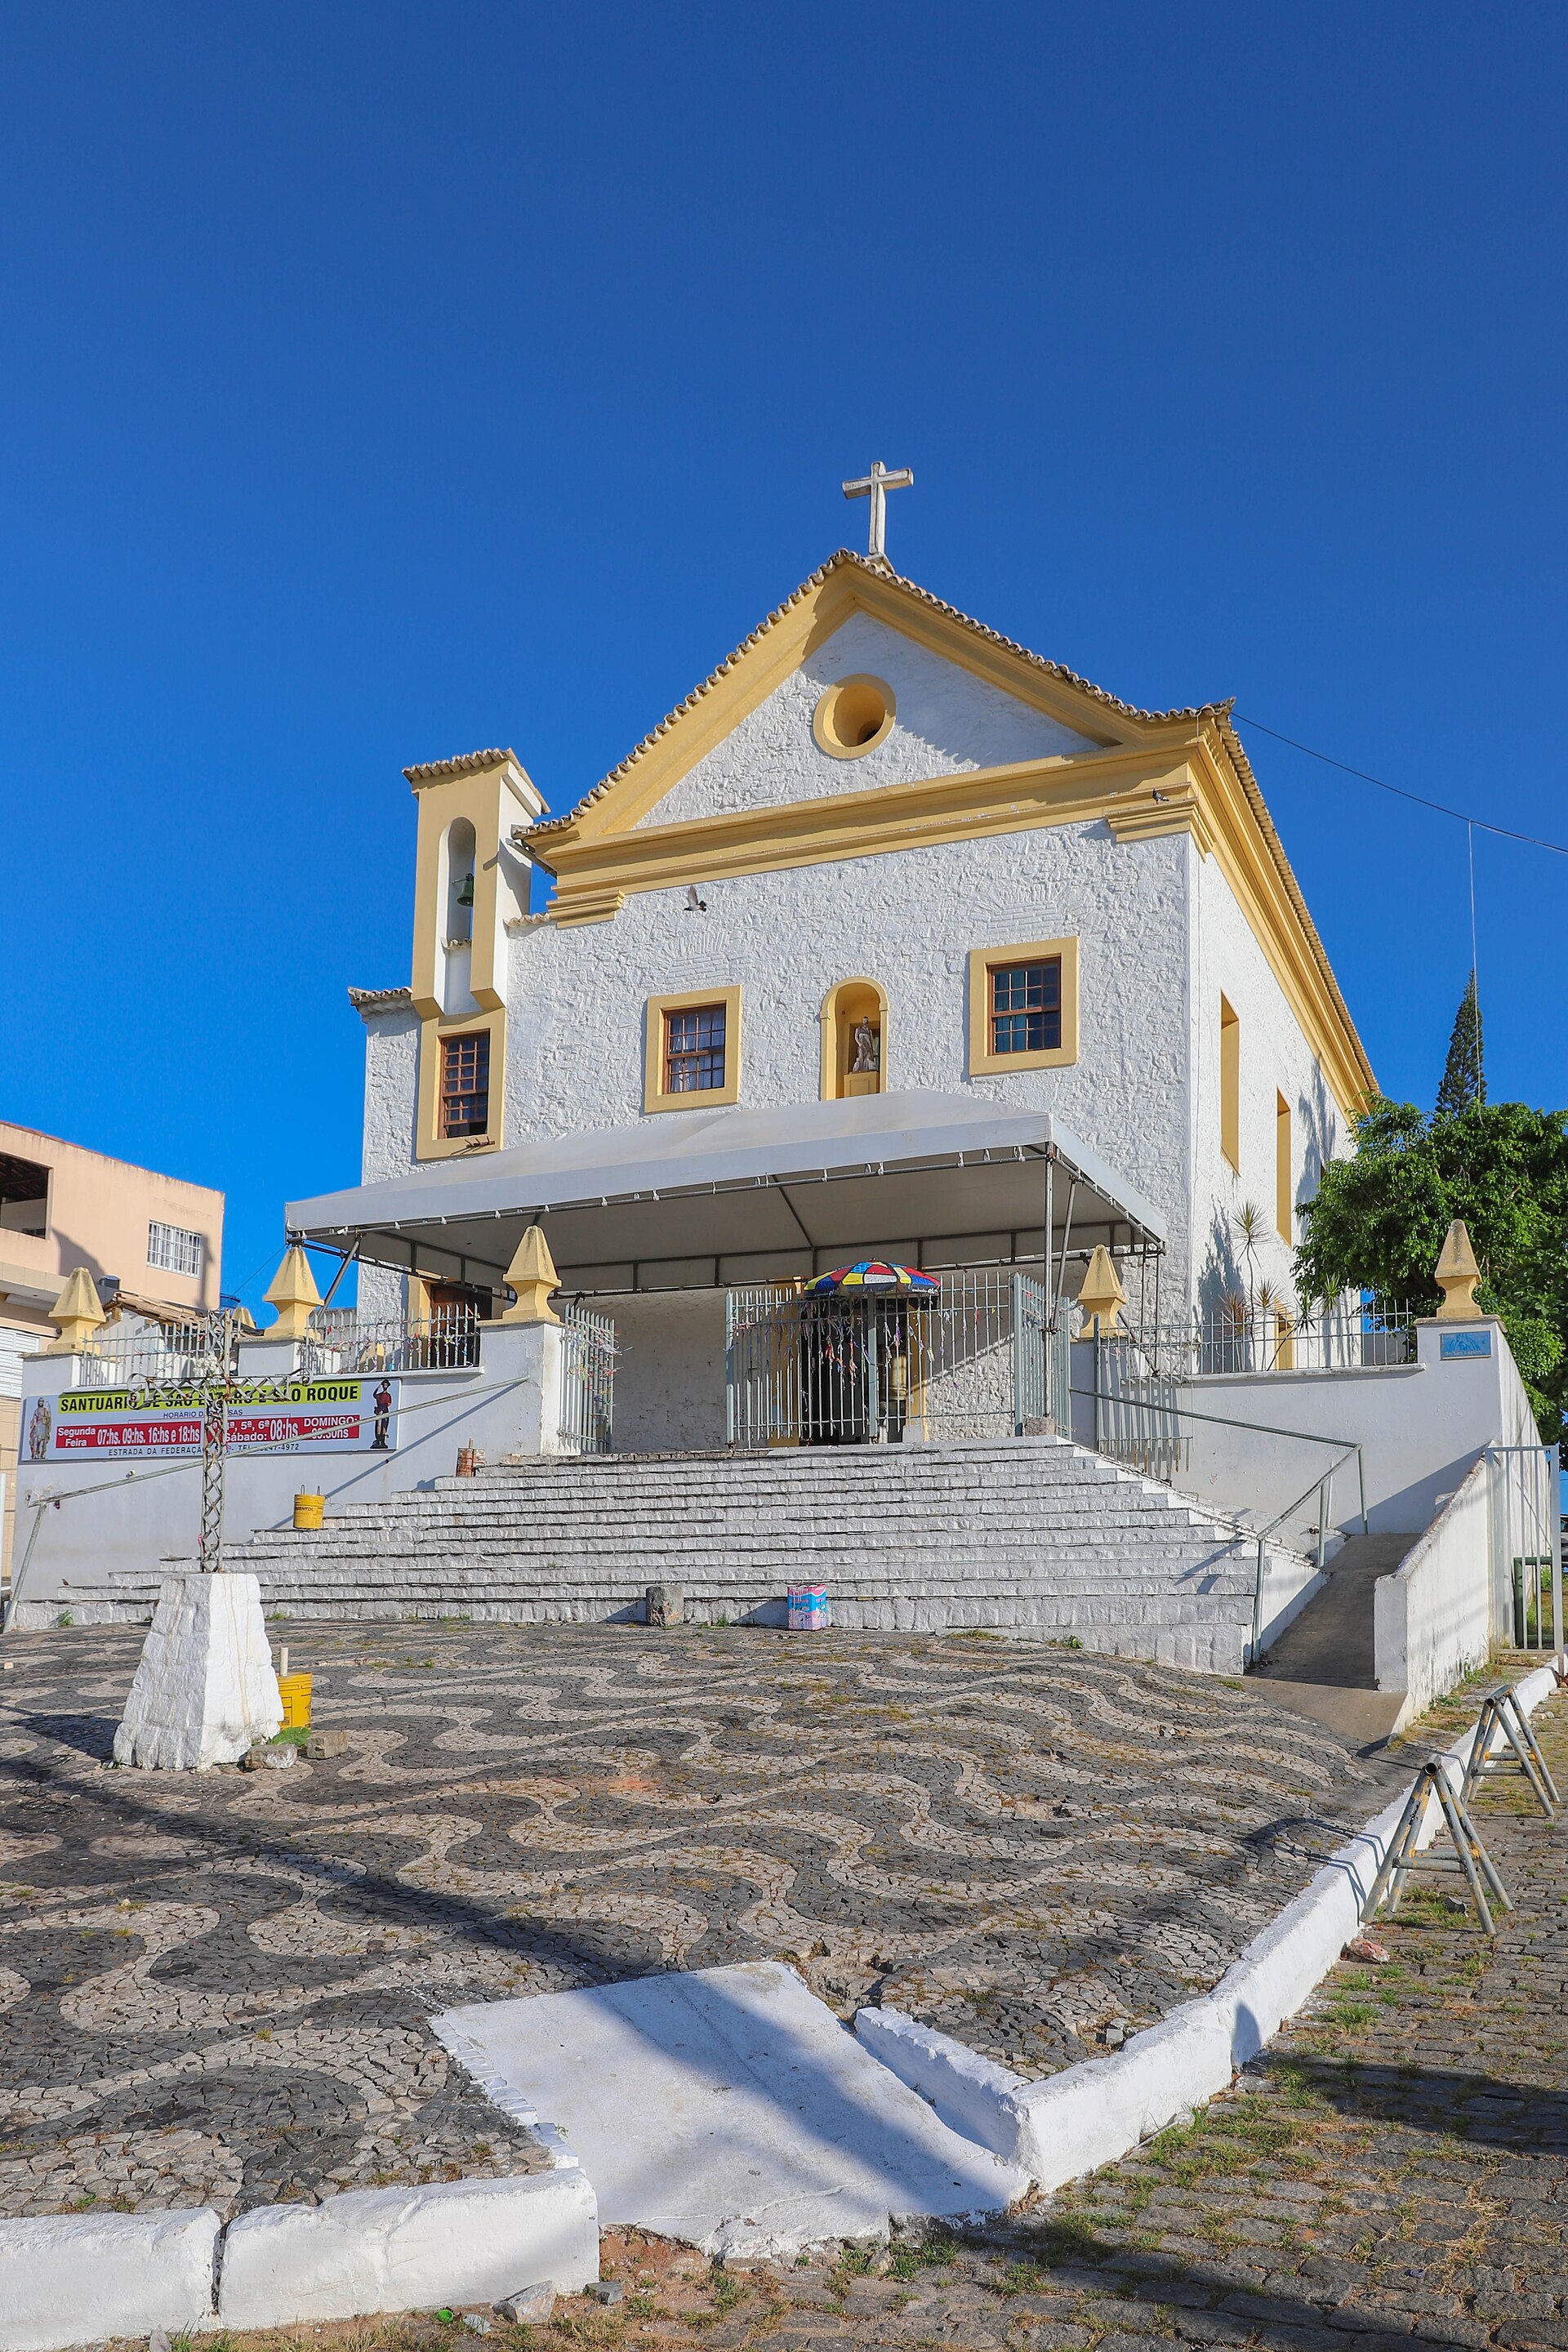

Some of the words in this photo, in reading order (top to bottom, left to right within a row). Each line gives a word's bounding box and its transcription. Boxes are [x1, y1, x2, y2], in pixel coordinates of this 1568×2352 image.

[307, 1385, 358, 1402] ROQUE
[163, 1410, 197, 1419] HORÁRIO
[241, 1421, 255, 1432] 5ª,
[258, 1420, 270, 1430] 6ª
[270, 1419, 299, 1441] 08:hs
[58, 1427, 96, 1436] Segunda
[97, 1430, 121, 1446] 07:hs.
[122, 1428, 146, 1444] 09:hs.
[149, 1427, 169, 1443] 16:hs
[171, 1431, 176, 1442] e
[178, 1425, 200, 1442] 18:hs
[225, 1432, 267, 1442] Sábado:
[65, 1438, 87, 1447] Feira
[109, 1447, 142, 1456] ESTRADA
[162, 1446, 208, 1455] FEDERAÇÃ
